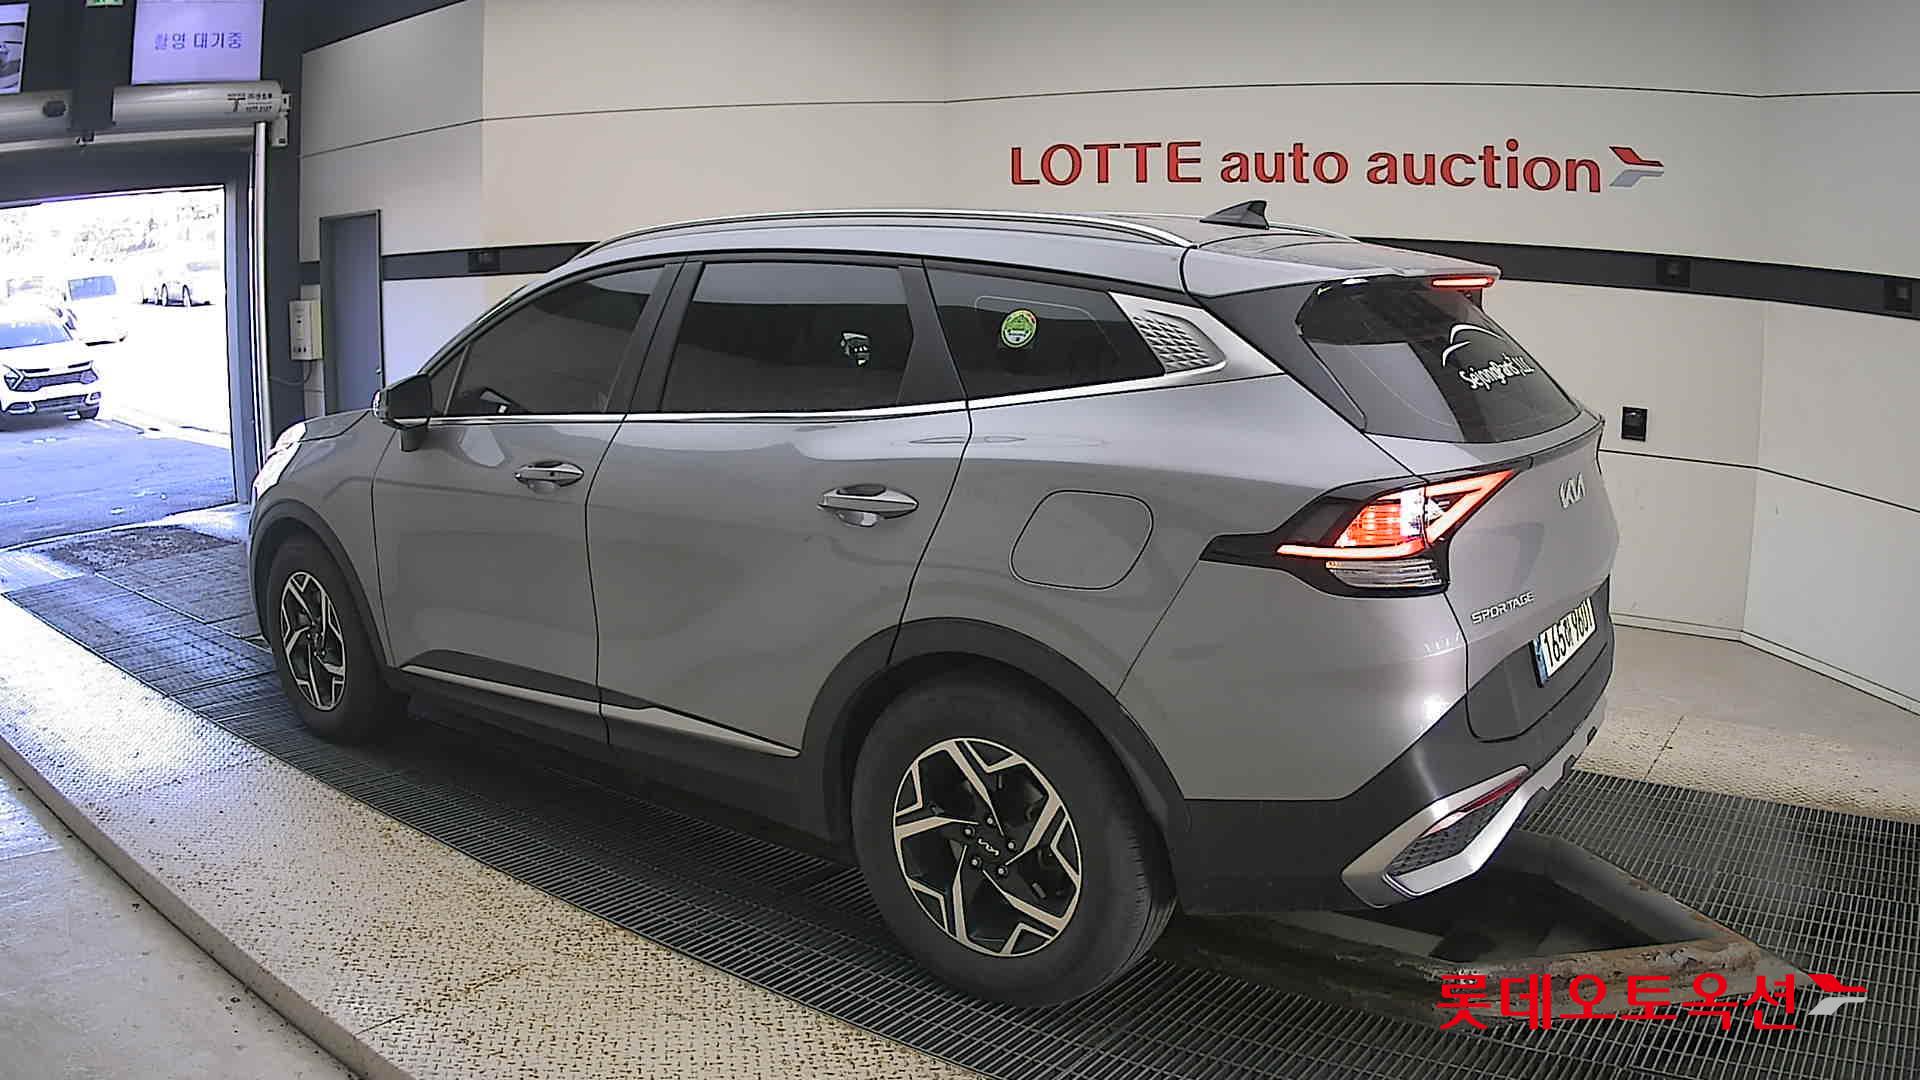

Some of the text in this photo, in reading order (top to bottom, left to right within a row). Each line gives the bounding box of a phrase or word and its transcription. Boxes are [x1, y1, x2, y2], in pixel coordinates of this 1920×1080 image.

[193, 31, 242, 49] 대기중
[1011, 138, 1601, 193] LOTTE auto auction
[1470, 591, 1535, 624] SPORTAGE
